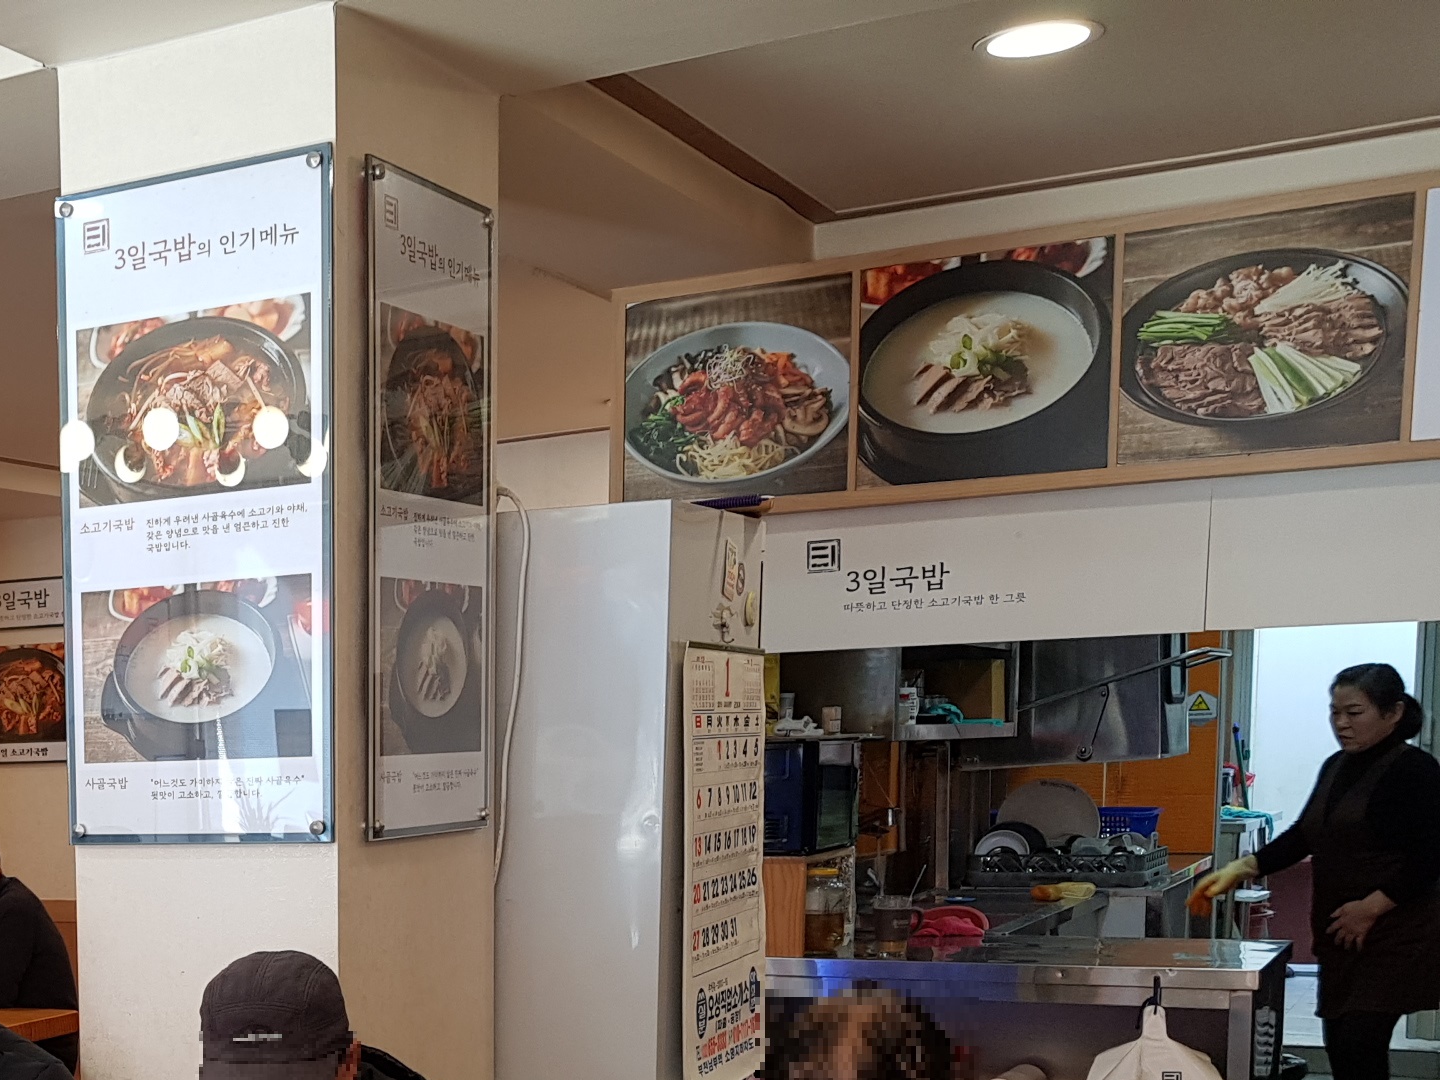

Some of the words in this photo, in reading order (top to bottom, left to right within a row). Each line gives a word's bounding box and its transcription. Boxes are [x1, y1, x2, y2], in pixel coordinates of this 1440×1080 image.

[114, 232, 211, 271] 3일국밥의
[218, 223, 300, 255] 인기메뉴
[399, 233, 446, 274] 3일국밥의
[79, 517, 136, 534] 소고기국밥
[146, 515, 171, 528] 진하게
[173, 513, 200, 526] 우려낸
[202, 508, 246, 523] 사골육수에
[247, 505, 285, 518] 소고기와
[286, 502, 308, 515] 야채,
[165, 526, 200, 539] 양념으로
[221, 522, 231, 534] 낸
[233, 519, 269, 533] 얼큰하고
[271, 516, 290, 529] 진한
[146, 539, 191, 553] 국밥입니다.
[845, 561, 951, 595] 3일국밥
[843, 600, 888, 613] 따뜻하고
[891, 597, 924, 611] 단정한
[927, 594, 985, 608] 소고기국밥
[988, 593, 1000, 605] 한
[1002, 591, 1027, 604] 그릇
[694, 715, 702, 728] 日
[706, 715, 713, 728] 月
[716, 715, 723, 728] 火
[733, 714, 740, 727] 木
[743, 714, 751, 727] 金
[717, 740, 722, 760] 1
[725, 740, 730, 760] 2
[733, 739, 738, 759] 3
[742, 738, 748, 758] 4
[753, 738, 759, 757] 5
[85, 776, 129, 790] 사골국밥
[696, 789, 702, 809] 6
[707, 788, 713, 807] 7
[725, 786, 730, 805] 9
[732, 784, 740, 804] 10
[740, 783, 747, 803] 11
[748, 781, 758, 800] 12
[694, 837, 702, 857] 13
[704, 834, 712, 855] 14
[713, 832, 722, 853] 15
[723, 830, 732, 850] 16
[733, 828, 740, 848] 17
[748, 824, 757, 844] 19
[692, 884, 701, 905] 20
[702, 881, 710, 902] 21
[711, 878, 720, 899] 22
[720, 875, 729, 896] 23
[729, 872, 738, 893] 24
[738, 869, 747, 890] 25
[747, 866, 758, 887] 26
[692, 928, 701, 951] 27
[701, 926, 710, 948] 28
[710, 922, 720, 945] 29
[720, 919, 729, 942] 30
[730, 916, 738, 938] 31
